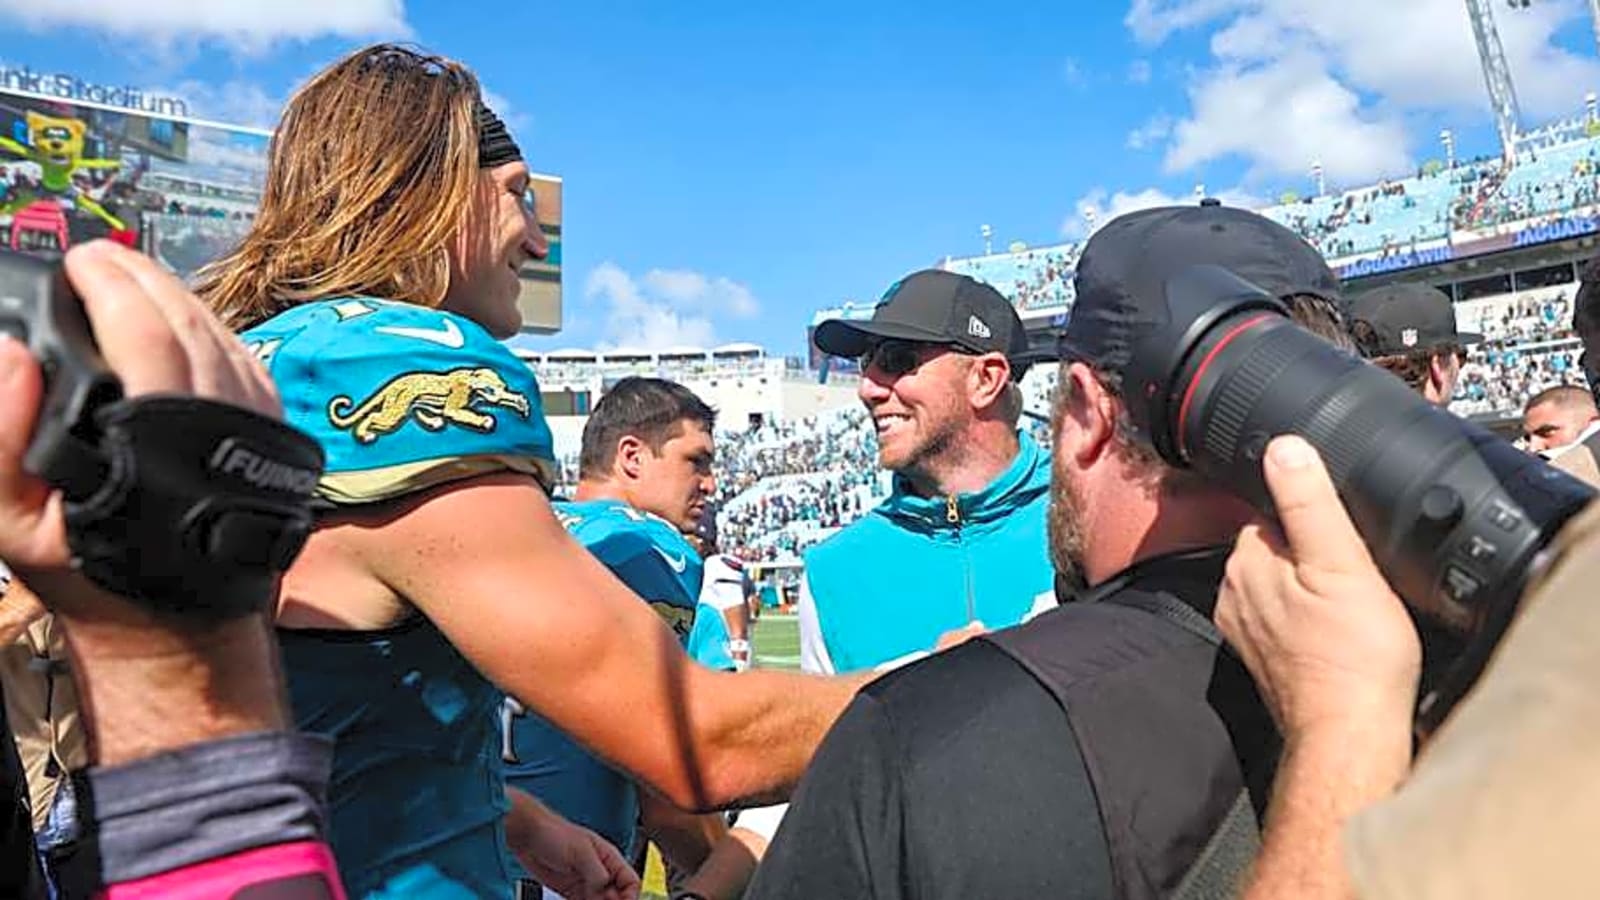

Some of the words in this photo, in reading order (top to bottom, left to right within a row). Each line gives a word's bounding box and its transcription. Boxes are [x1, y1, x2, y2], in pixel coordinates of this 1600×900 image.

[0, 65, 41, 92] nk
[55, 72, 187, 116] Stadium
[1513, 216, 1597, 246] JAGUARS
[1342, 255, 1412, 277] JAGUARS
